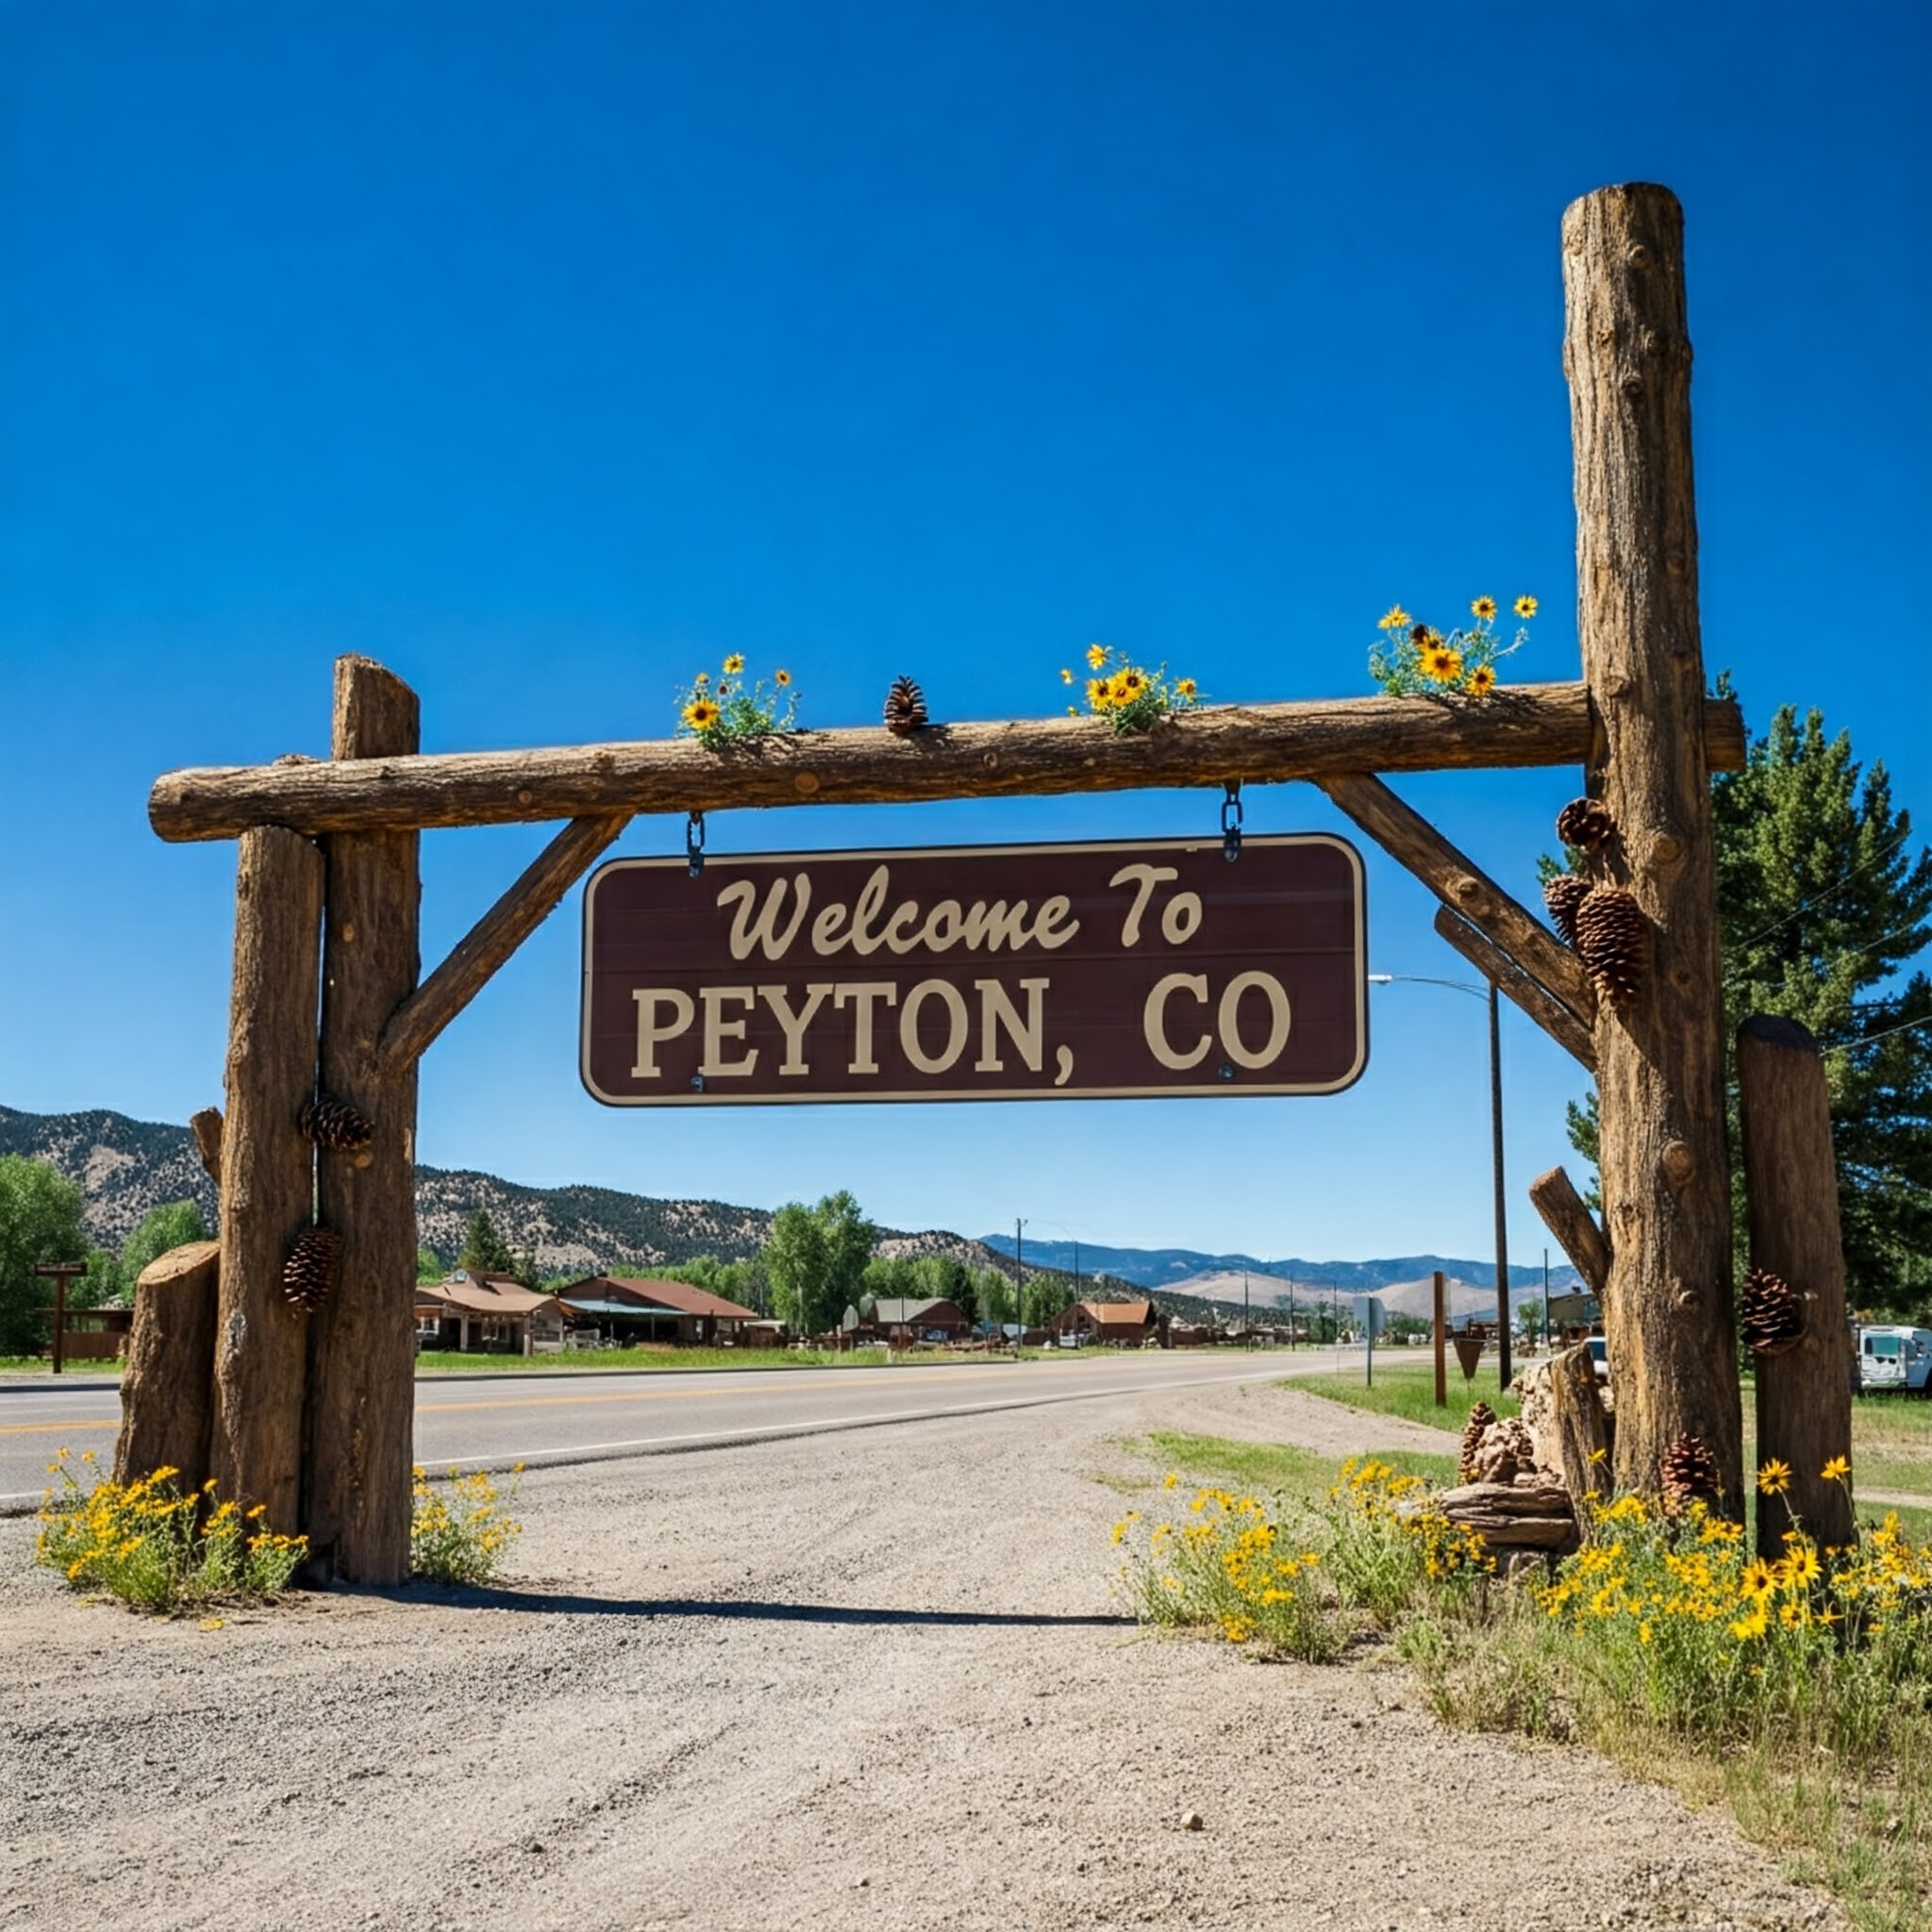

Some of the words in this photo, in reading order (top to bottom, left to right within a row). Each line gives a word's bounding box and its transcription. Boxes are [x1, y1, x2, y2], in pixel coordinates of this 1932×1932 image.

[717, 865, 1080, 960] Welcome
[1109, 863, 1202, 947] To
[631, 977, 1074, 1086] PEYTON,
[1143, 971, 1291, 1070] CO
